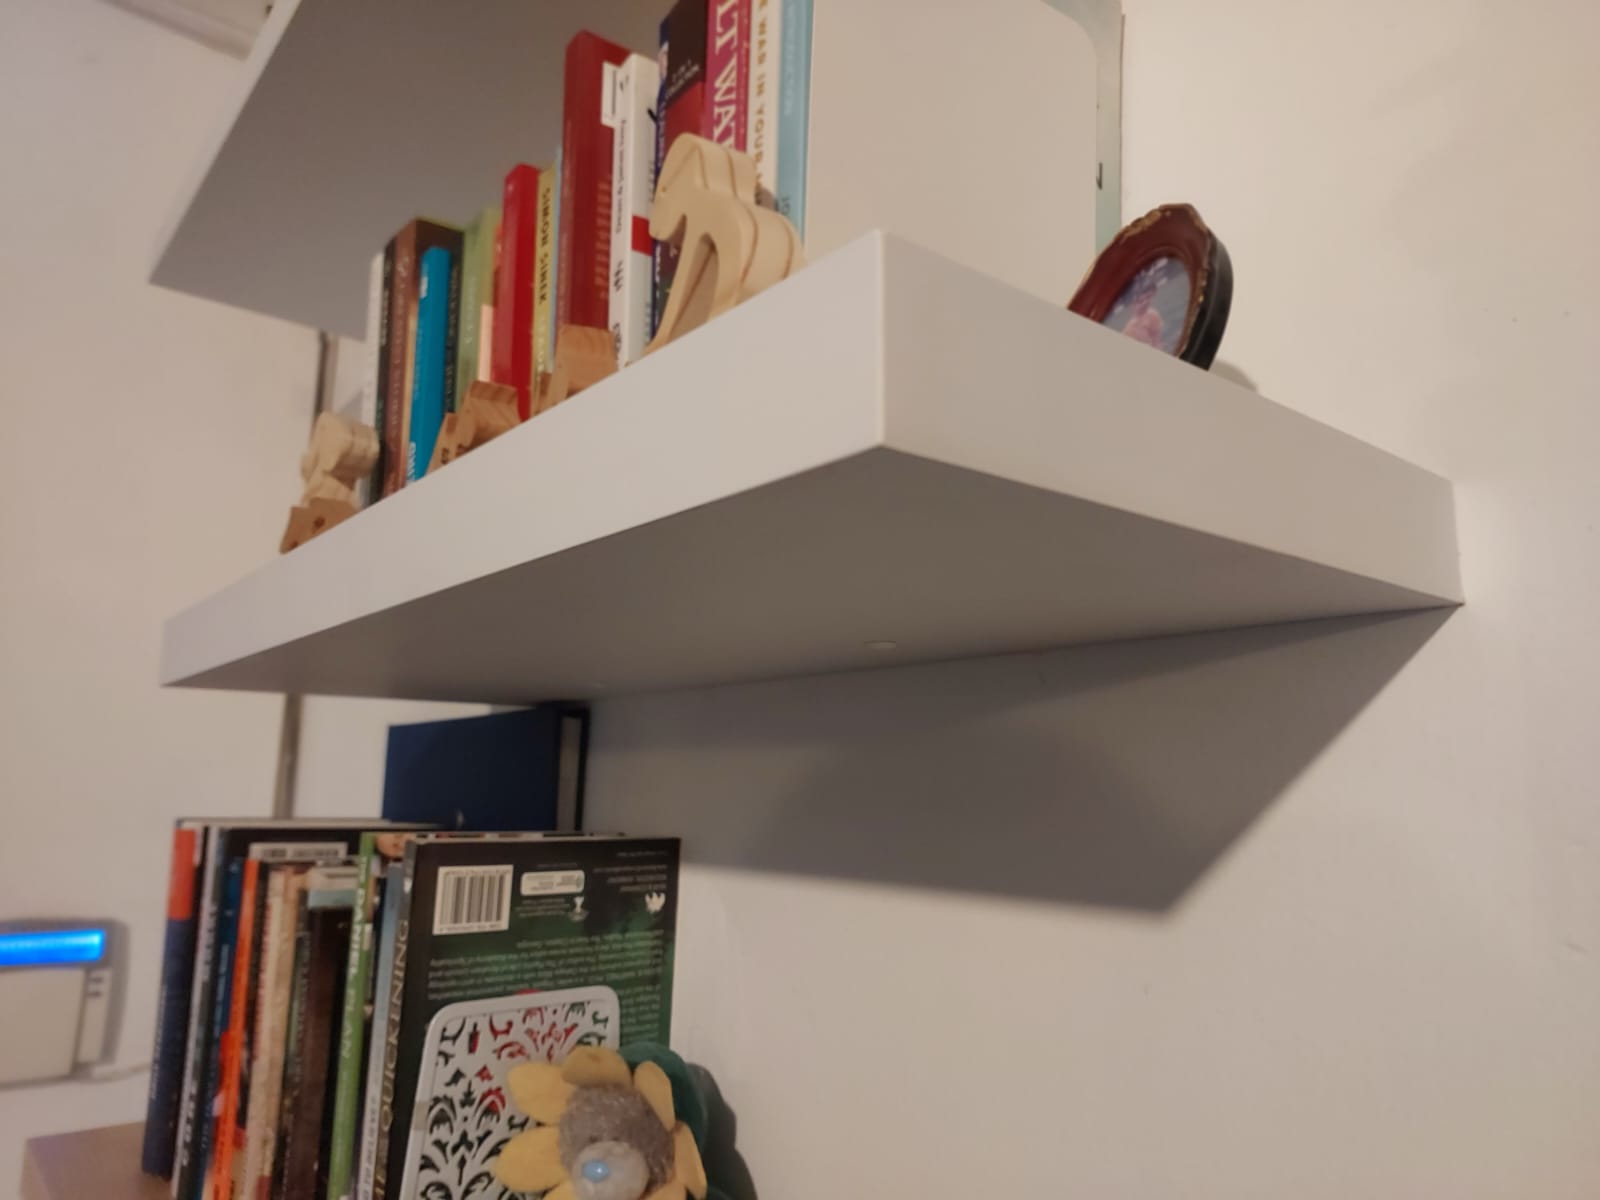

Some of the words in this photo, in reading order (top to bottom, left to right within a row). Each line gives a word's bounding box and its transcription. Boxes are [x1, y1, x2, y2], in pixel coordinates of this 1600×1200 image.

[540, 187, 552, 246] SIMON
[538, 252, 550, 305] SINEK
[348, 887, 366, 982] DANIEL
[341, 987, 357, 1058] PLAN
[382, 918, 410, 1132] QUICKENING
